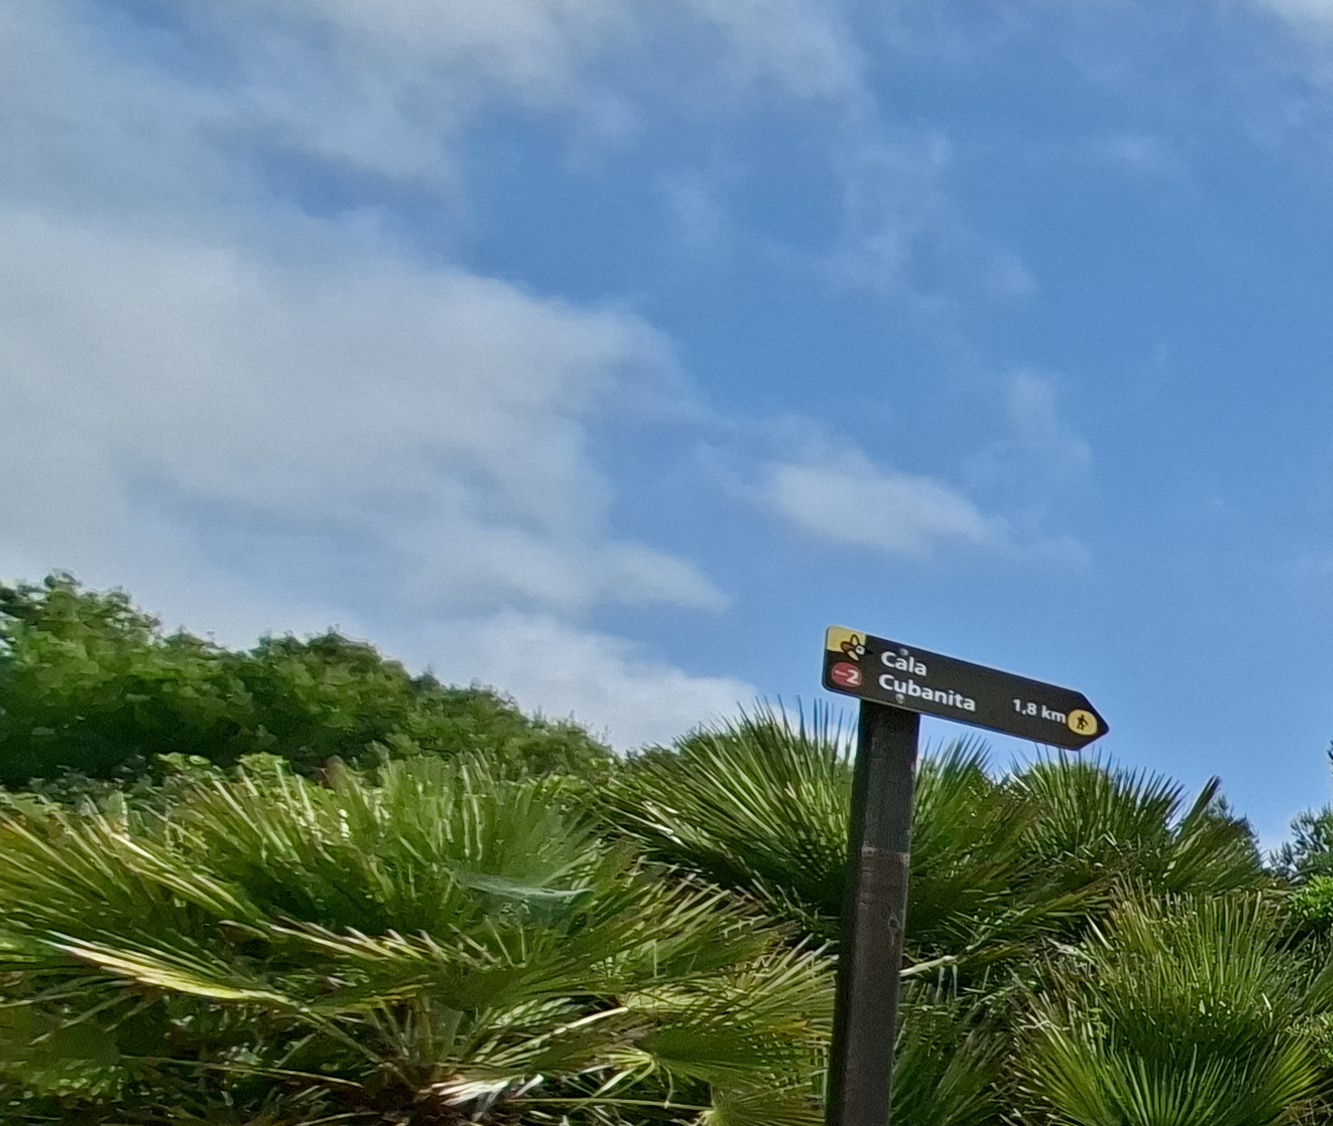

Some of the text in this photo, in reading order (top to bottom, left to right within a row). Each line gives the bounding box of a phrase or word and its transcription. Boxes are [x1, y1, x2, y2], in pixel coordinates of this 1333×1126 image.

[881, 651, 927, 676] Cala
[879, 674, 976, 712] Cubanita
[1013, 699, 1066, 724] 1,8 km
